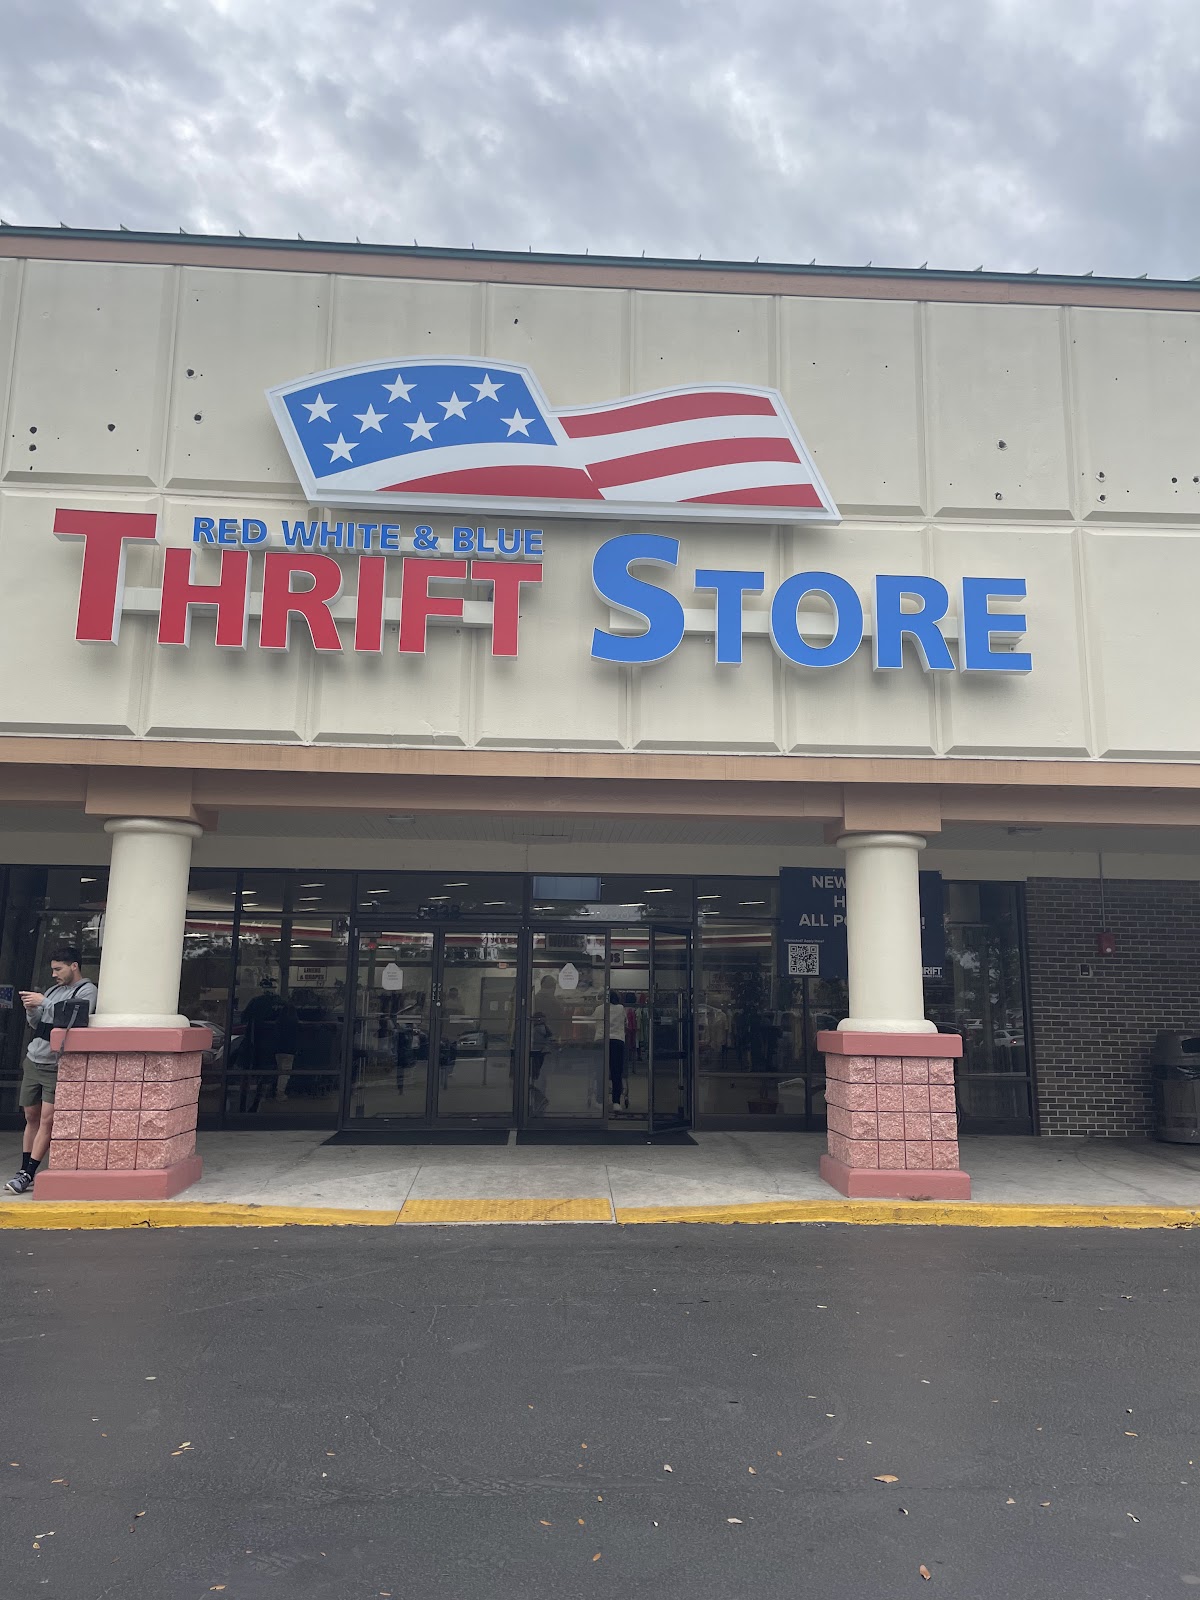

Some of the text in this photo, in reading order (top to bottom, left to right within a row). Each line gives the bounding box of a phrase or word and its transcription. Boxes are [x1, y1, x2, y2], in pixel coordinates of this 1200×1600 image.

[193, 516, 544, 556] RED WHITE & BLUE
[53, 508, 1033, 672] THRIFT STORE
[799, 914, 829, 927] ALL
[922, 966, 943, 976] RIFT
